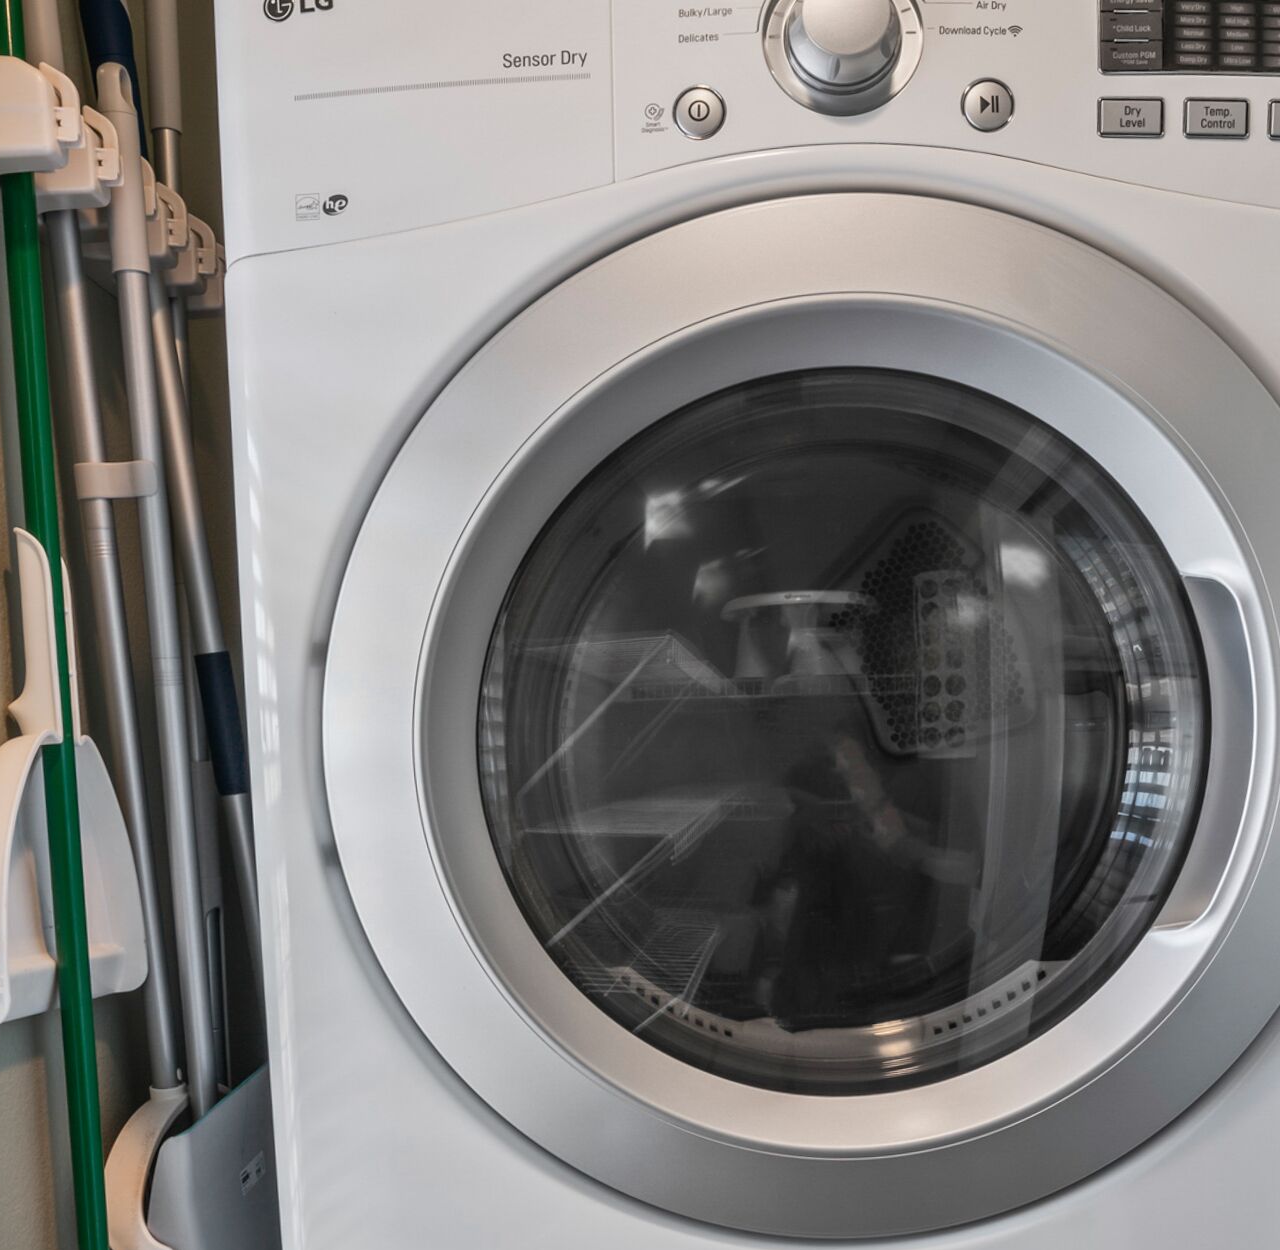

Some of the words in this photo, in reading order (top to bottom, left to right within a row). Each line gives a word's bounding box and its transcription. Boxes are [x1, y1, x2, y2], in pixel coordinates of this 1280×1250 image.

[300, 0, 334, 13] LG
[976, 0, 989, 10] Air
[991, 0, 1007, 11] Dry
[678, 7, 733, 18] Bulky/Large
[939, 25, 982, 35] Download
[983, 26, 1007, 37] Cycle
[678, 32, 720, 44] Delicates
[503, 52, 557, 69] Sensor
[560, 49, 588, 68] Dry
[1124, 106, 1142, 118] Dry
[1204, 106, 1232, 118] Temp.
[1120, 118, 1146, 128] Level
[1200, 118, 1235, 129] Control
